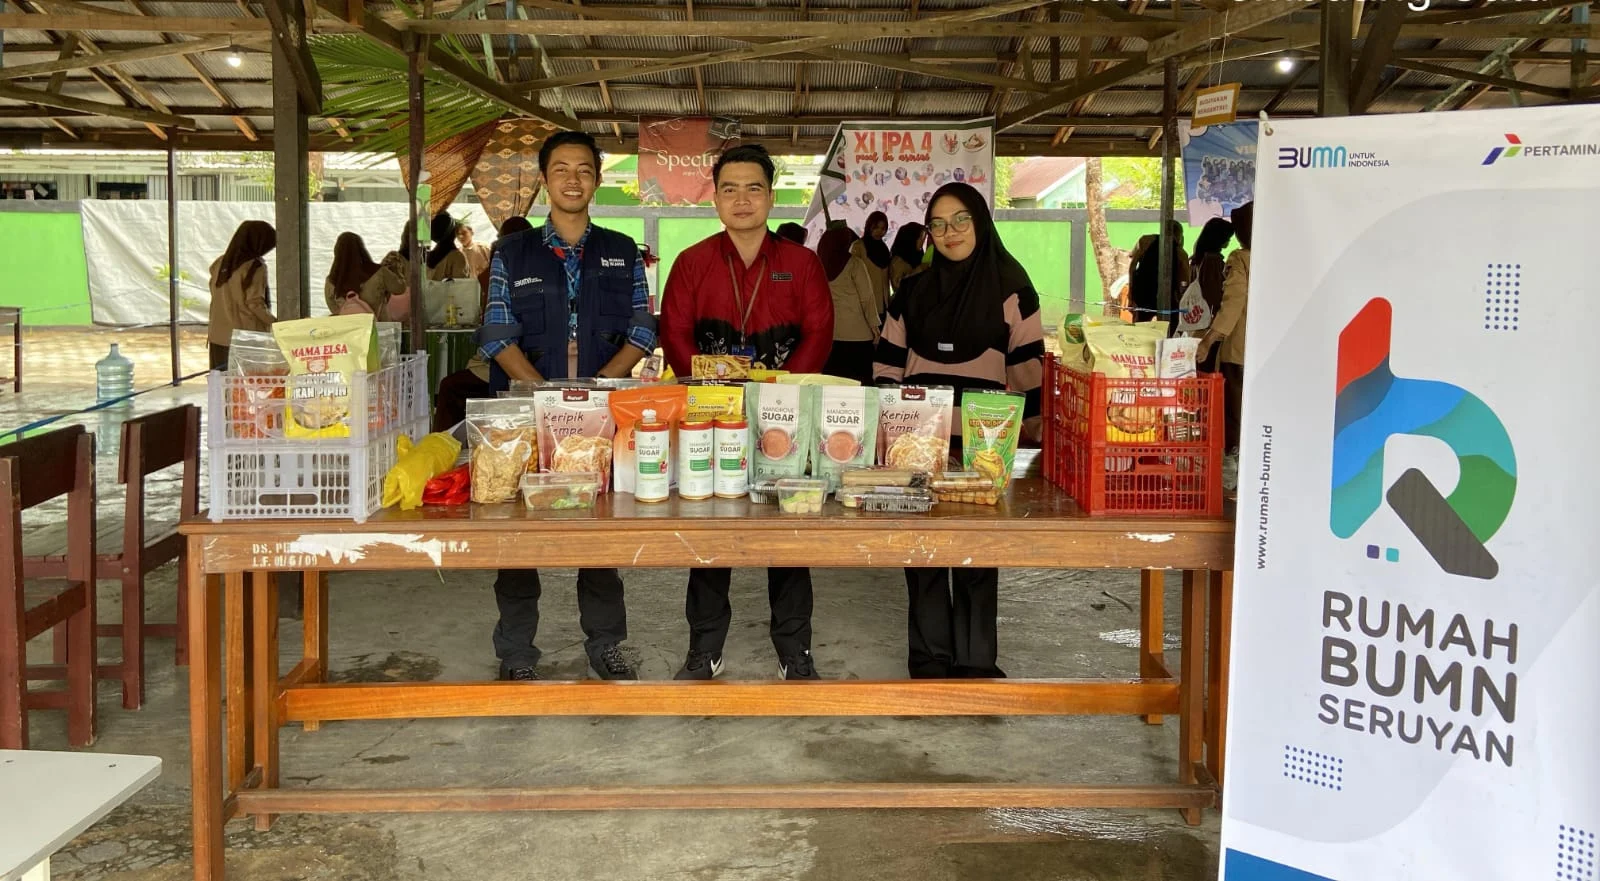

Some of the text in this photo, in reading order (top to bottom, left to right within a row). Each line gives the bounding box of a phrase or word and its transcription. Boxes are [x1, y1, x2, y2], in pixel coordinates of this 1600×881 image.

[854, 131, 933, 154] XI IPA 4
[1278, 145, 1346, 169] BUMN
[1349, 152, 1376, 160] UNTUK
[1524, 143, 1600, 157] PERTAMIN
[656, 151, 719, 172] Spectr
[1348, 159, 1390, 168] INDONESIA
[291, 343, 348, 358] MAMA ELSA
[1111, 354, 1155, 366] MAMA ELS
[543, 412, 584, 425] Keripik
[761, 412, 795, 422] SUGAR
[826, 415, 860, 425] SUGAR
[881, 410, 920, 421] Keripik
[689, 446, 710, 454] SUGAR
[1257, 425, 1273, 569] www.rumah-bumn.id
[1322, 590, 1518, 664] RUMAH
[1321, 636, 1517, 723] BUMN
[1318, 693, 1514, 767] SERUYAN
